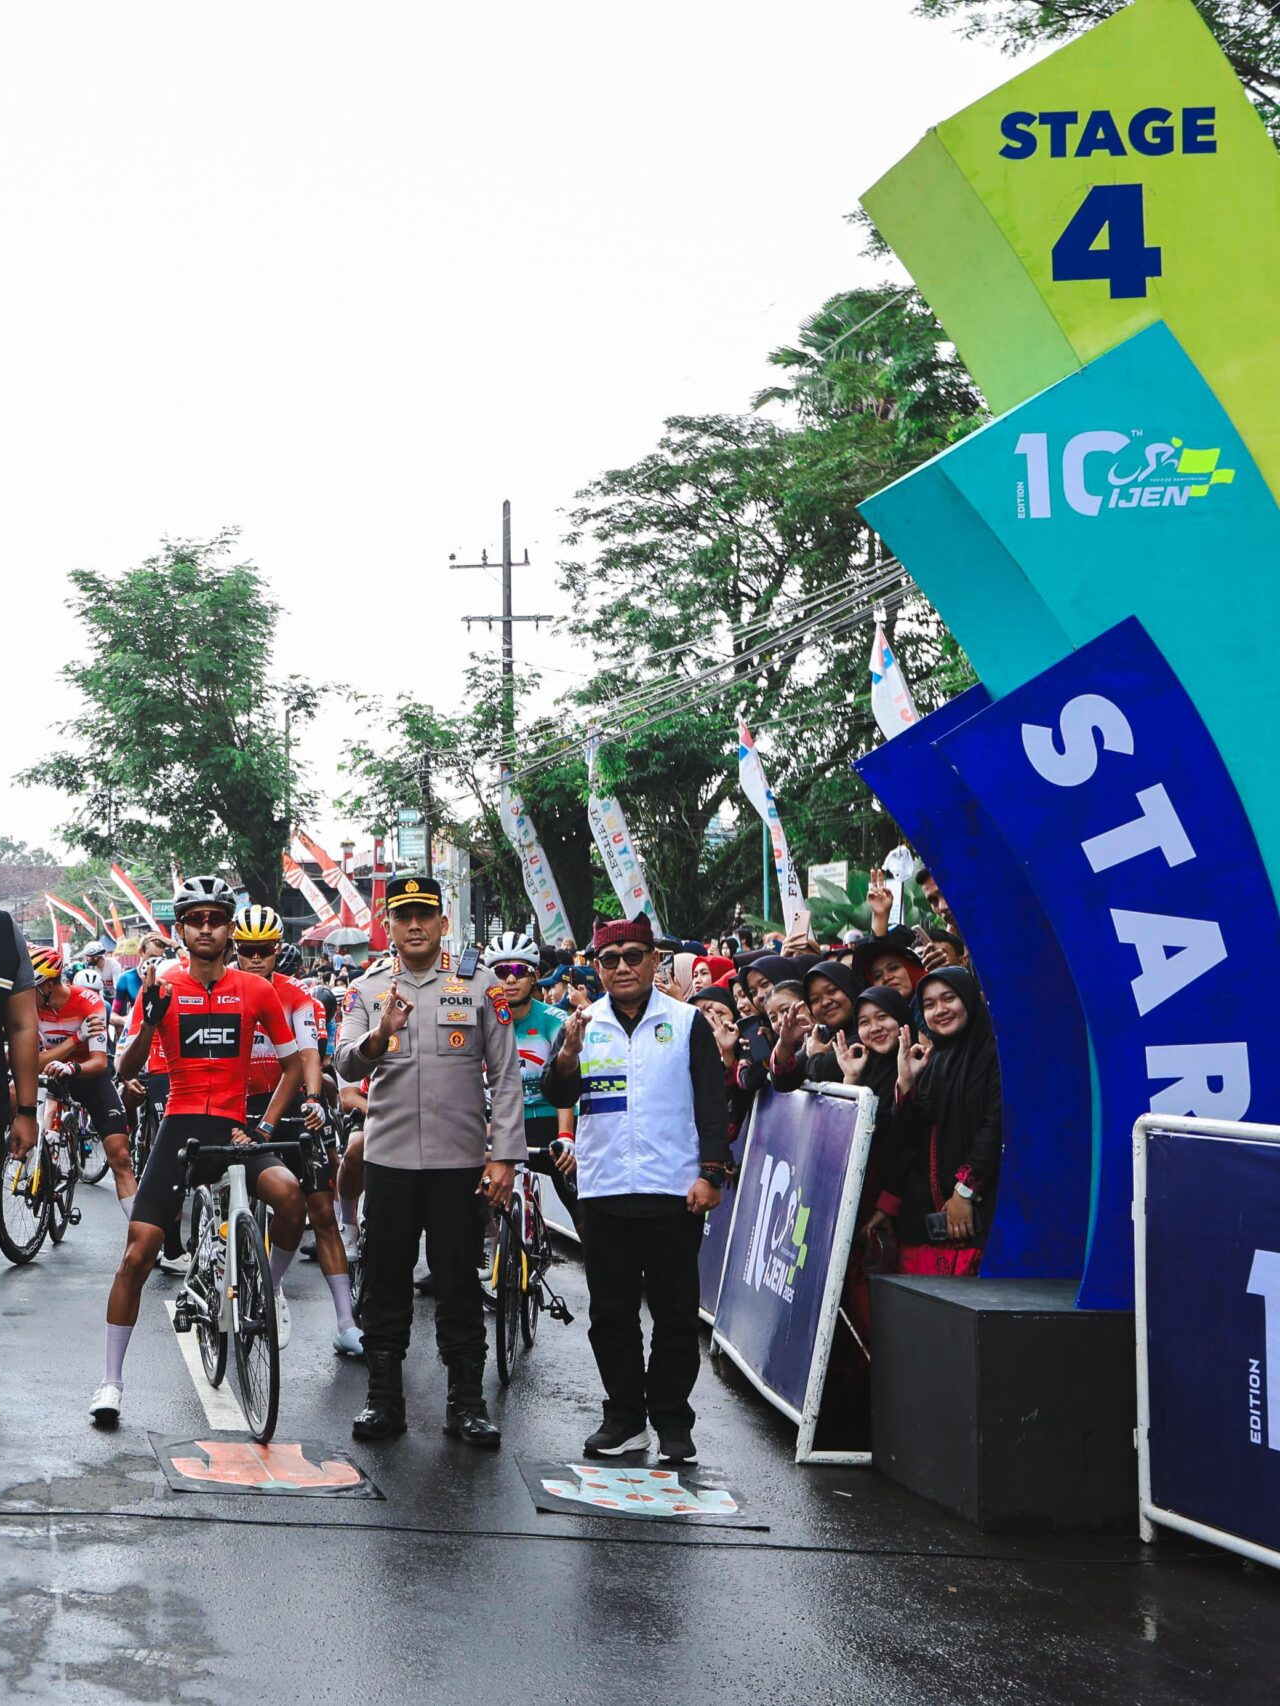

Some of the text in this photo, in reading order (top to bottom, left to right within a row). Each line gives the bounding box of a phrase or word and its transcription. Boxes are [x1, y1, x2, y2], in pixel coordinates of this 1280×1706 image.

[999, 106, 1217, 160] STAGE
[1051, 183, 1162, 300] 4
[1018, 482, 1026, 519] EDITION
[1108, 485, 1191, 508] IJEN
[1022, 693, 1251, 1123] STAR
[440, 997, 472, 1006] POLRI
[185, 1028, 235, 1045] ASC
[763, 1253, 789, 1297] IJEN
[1249, 1359, 1262, 1445] EDITION
